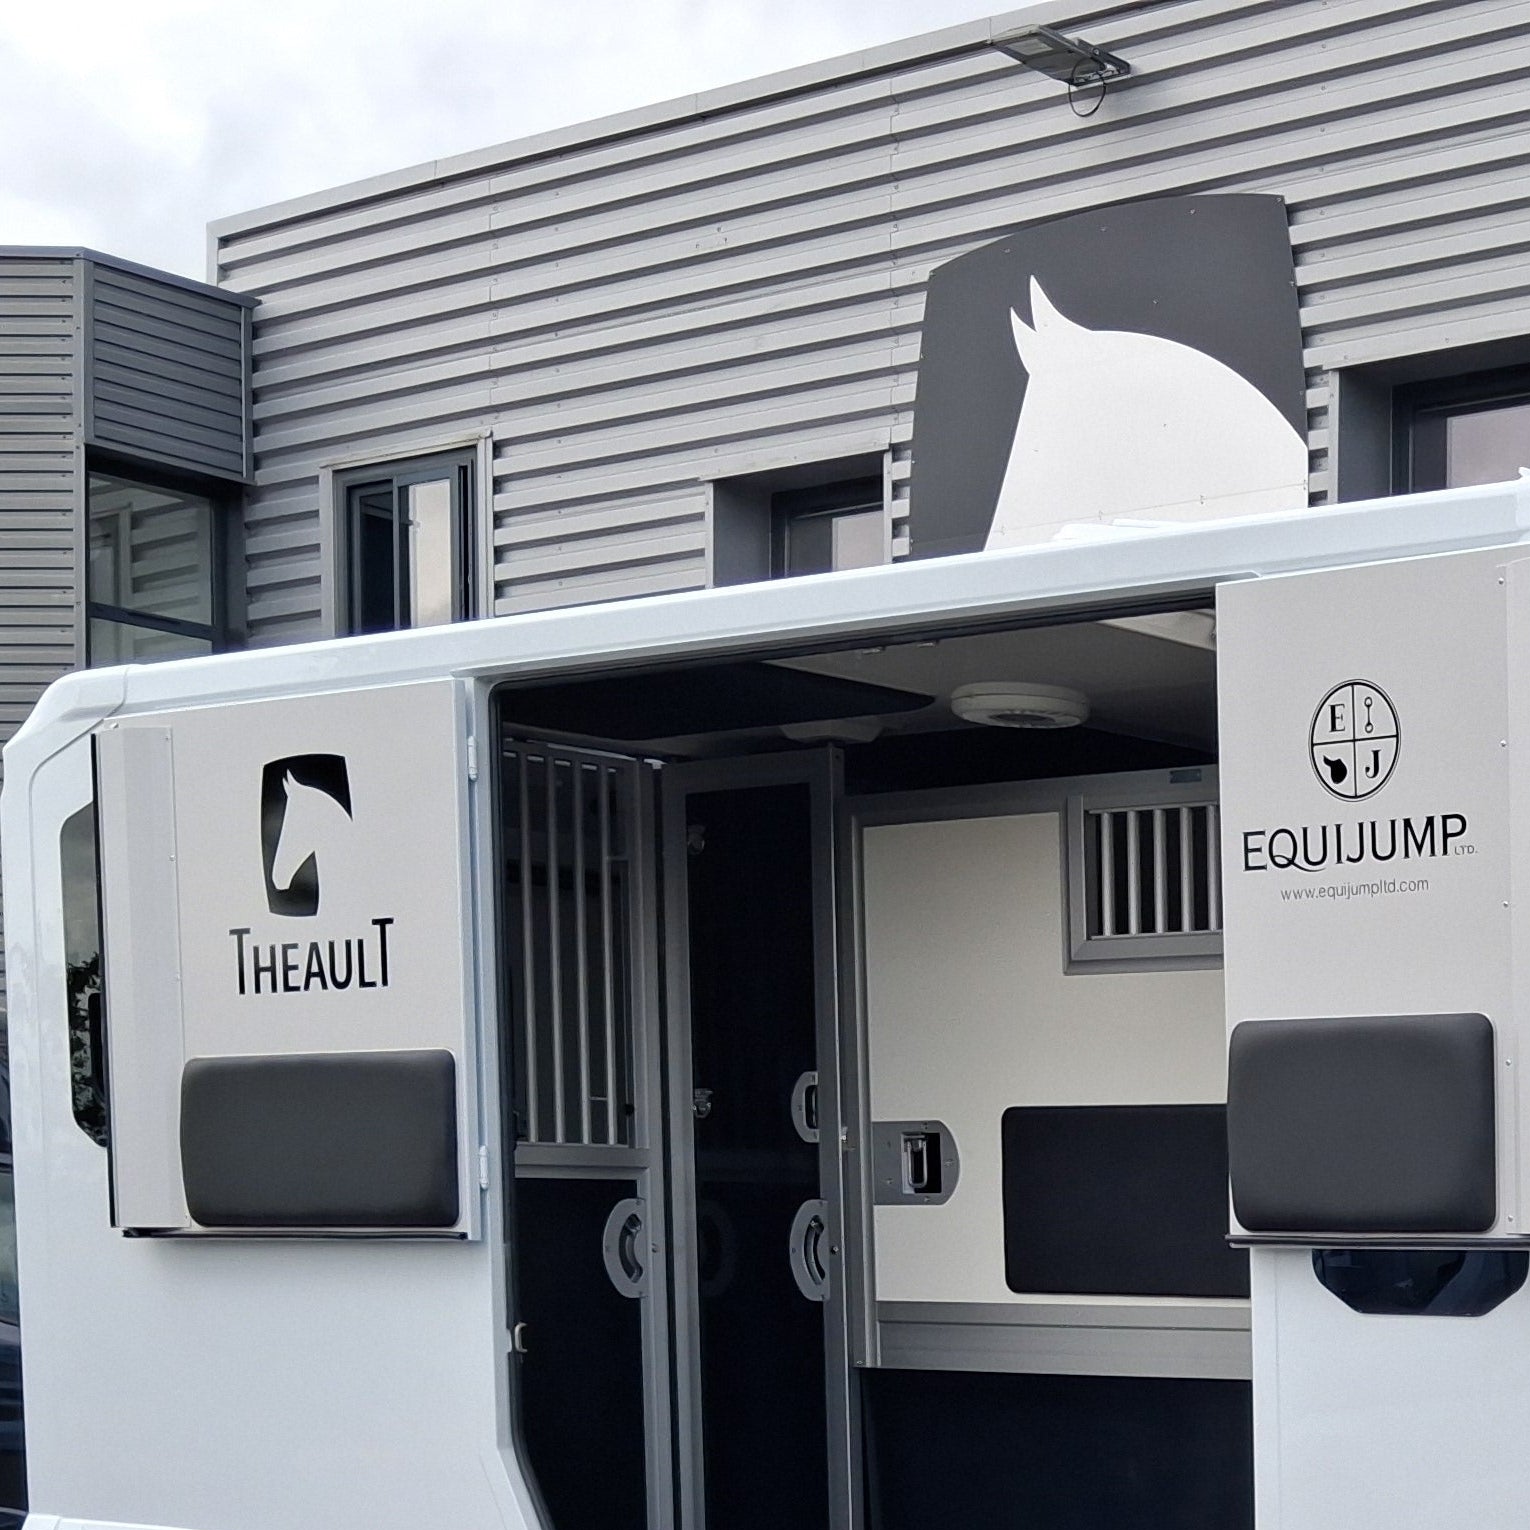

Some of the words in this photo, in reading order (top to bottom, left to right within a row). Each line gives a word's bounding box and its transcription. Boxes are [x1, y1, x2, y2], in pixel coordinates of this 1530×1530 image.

[1242, 813, 1468, 873] EQUIJUMP
[1280, 877, 1429, 901] www.equijumpltd.com
[229, 917, 394, 995] THEAULT
